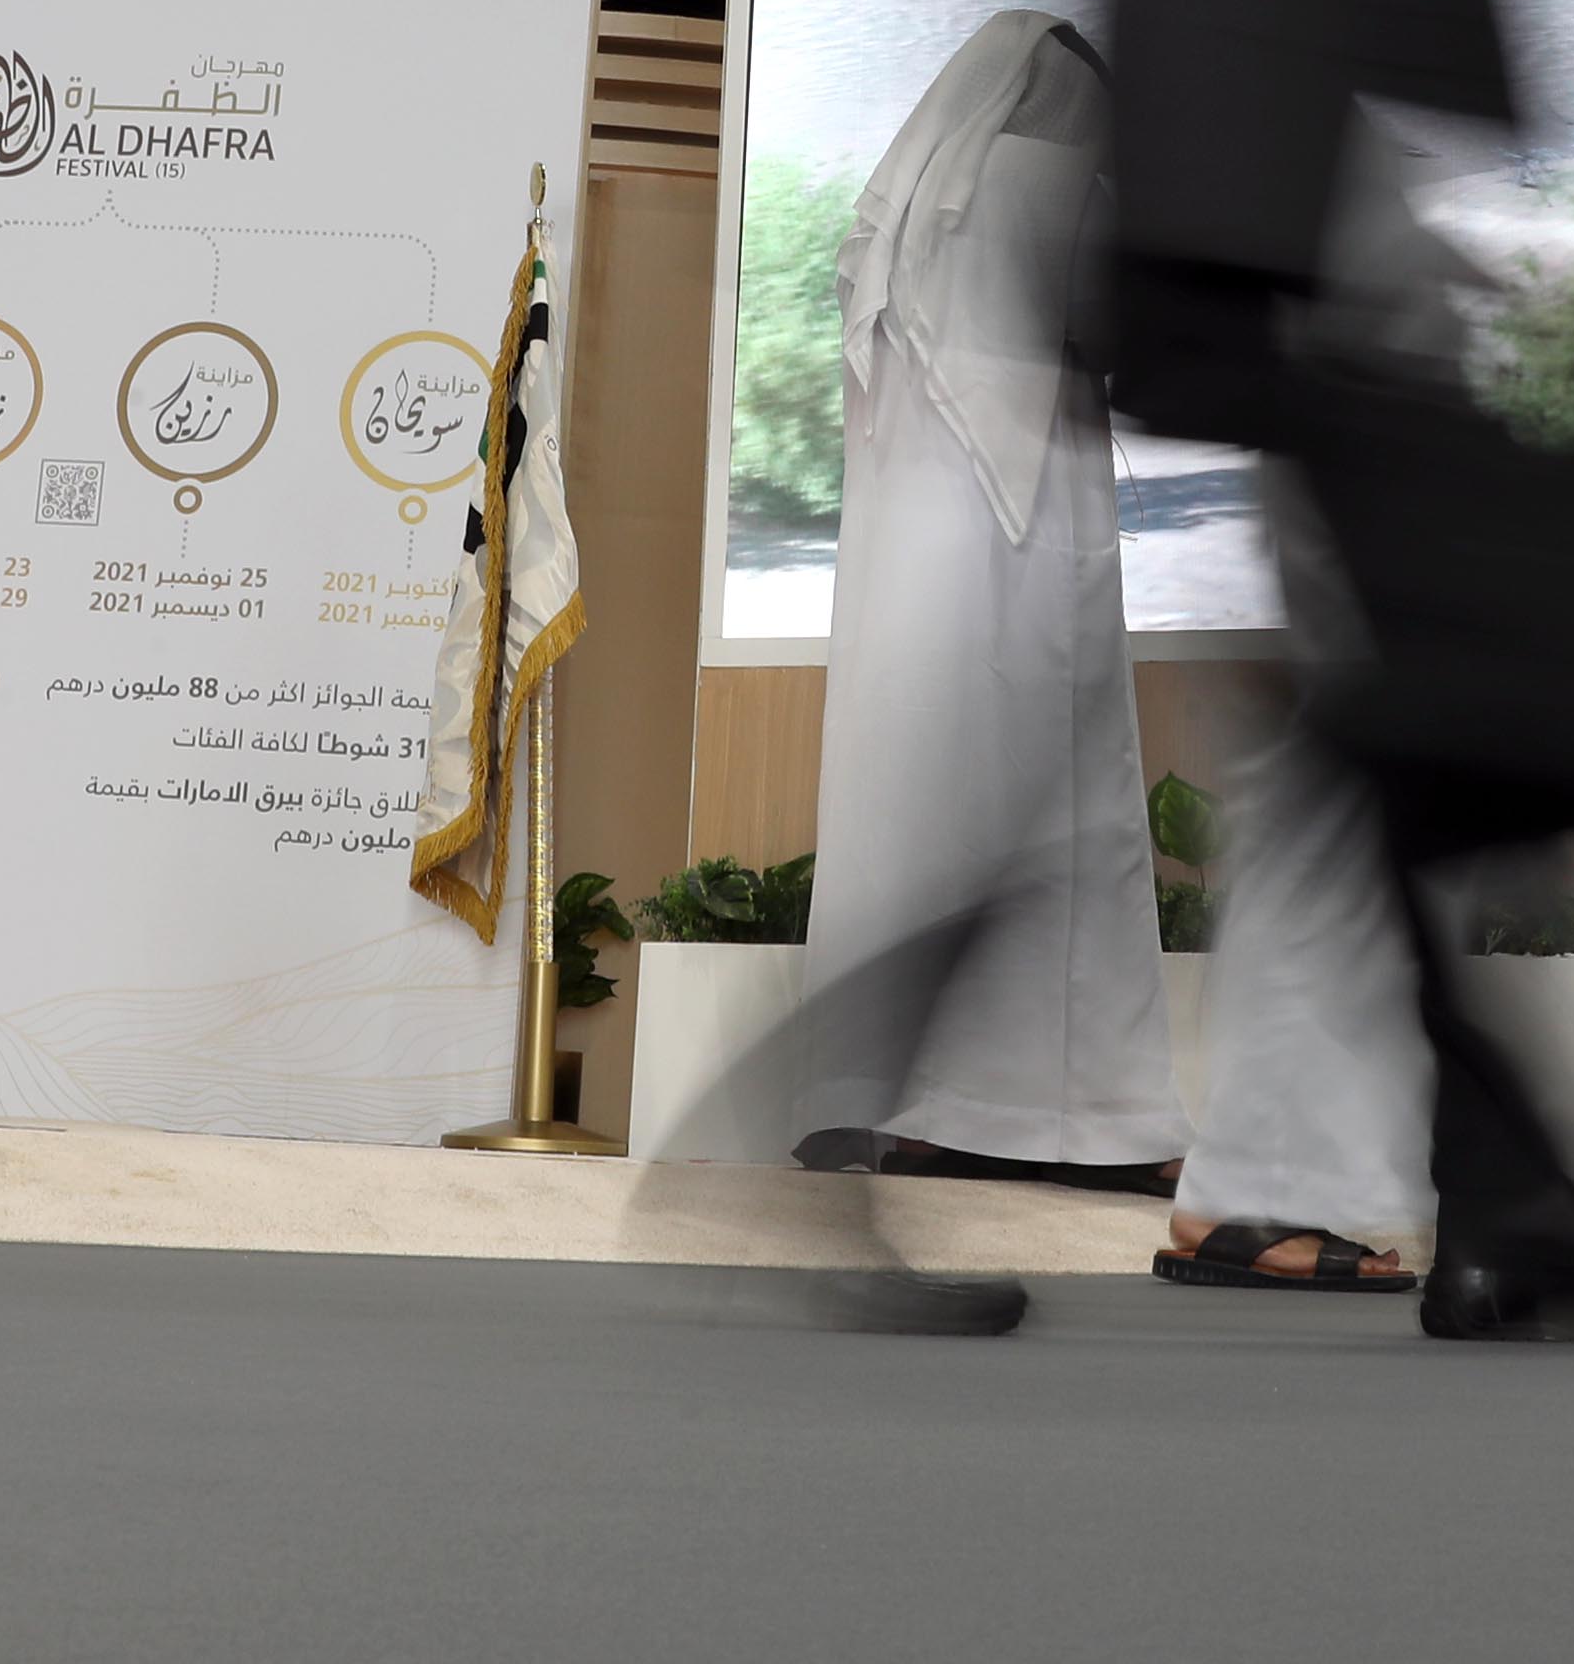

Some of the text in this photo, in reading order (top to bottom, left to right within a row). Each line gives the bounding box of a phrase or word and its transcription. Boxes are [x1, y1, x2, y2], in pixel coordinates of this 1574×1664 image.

[191, 53, 285, 79] مهرجان
[64, 77, 281, 120] الظفرة
[59, 124, 275, 161] AL DHAFRA
[56, 159, 186, 180] FESTIVAL (15)
[195, 366, 254, 390] مزاينة
[416, 372, 481, 396] مزاينة
[4, 557, 31, 578] 23
[92, 561, 268, 590] 25 نوفمبر 2021
[322, 571, 378, 593] 2021
[0, 587, 29, 608] 29
[89, 591, 265, 622] 01 ديسمبر 2021
[317, 602, 447, 633] وفمبر 2021
[45, 676, 104, 700] درهم
[111, 675, 180, 701] مليون
[189, 677, 219, 699] 88
[225, 684, 260, 705] من
[312, 683, 382, 712] الجوائز
[391, 689, 432, 715] يمة
[172, 726, 243, 750] الفئات
[251, 730, 308, 753] لكافة
[85, 776, 149, 803] بقيمة
[255, 785, 303, 813] بيرق
[311, 785, 362, 815] جائزة
[274, 827, 411, 854] مليون درهم
